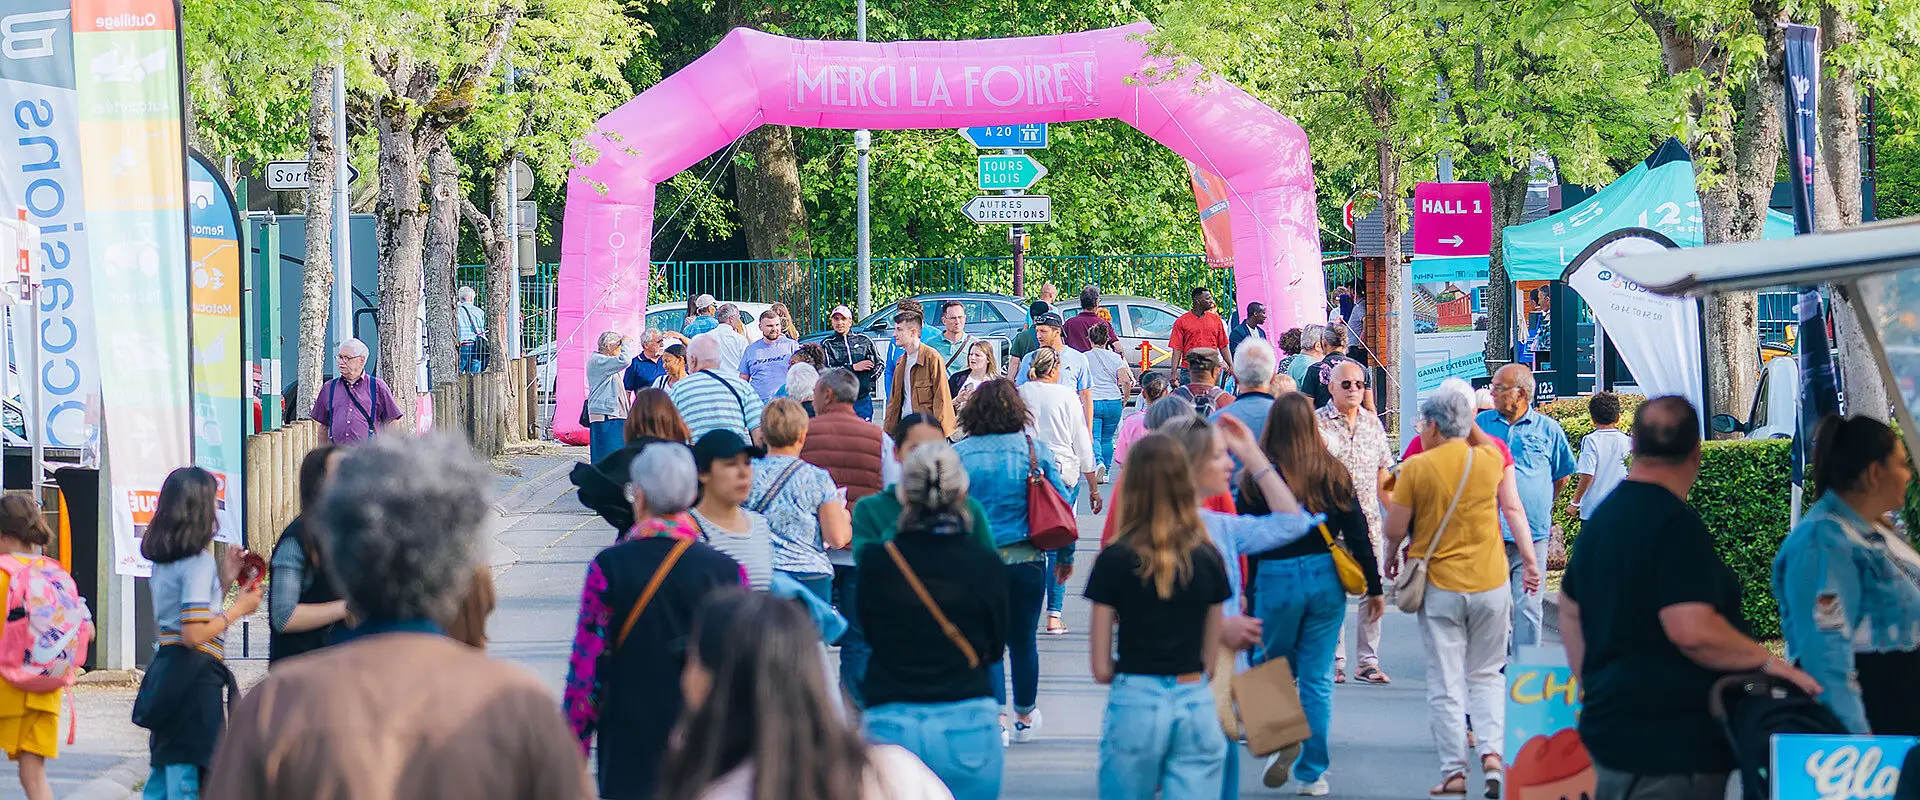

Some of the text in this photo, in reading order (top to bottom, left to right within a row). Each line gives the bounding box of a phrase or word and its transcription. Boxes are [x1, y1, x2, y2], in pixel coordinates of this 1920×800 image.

[797, 62, 897, 106] MERCI
[910, 65, 953, 106] LA
[964, 62, 1072, 106] FOIRE
[985, 126, 1012, 136] A 20
[984, 161, 1023, 171] TOURS
[984, 173, 1020, 184] BLOIS
[979, 200, 1022, 210] AUTRES
[1422, 199, 1482, 214] HALL 1
[979, 210, 1046, 220] DIRECTIONS
[1417, 365, 1445, 378] GAMME
[1445, 356, 1483, 371] EXTÉRIEUR
[1538, 381, 1554, 394] 123
[1510, 671, 1585, 706] CH
